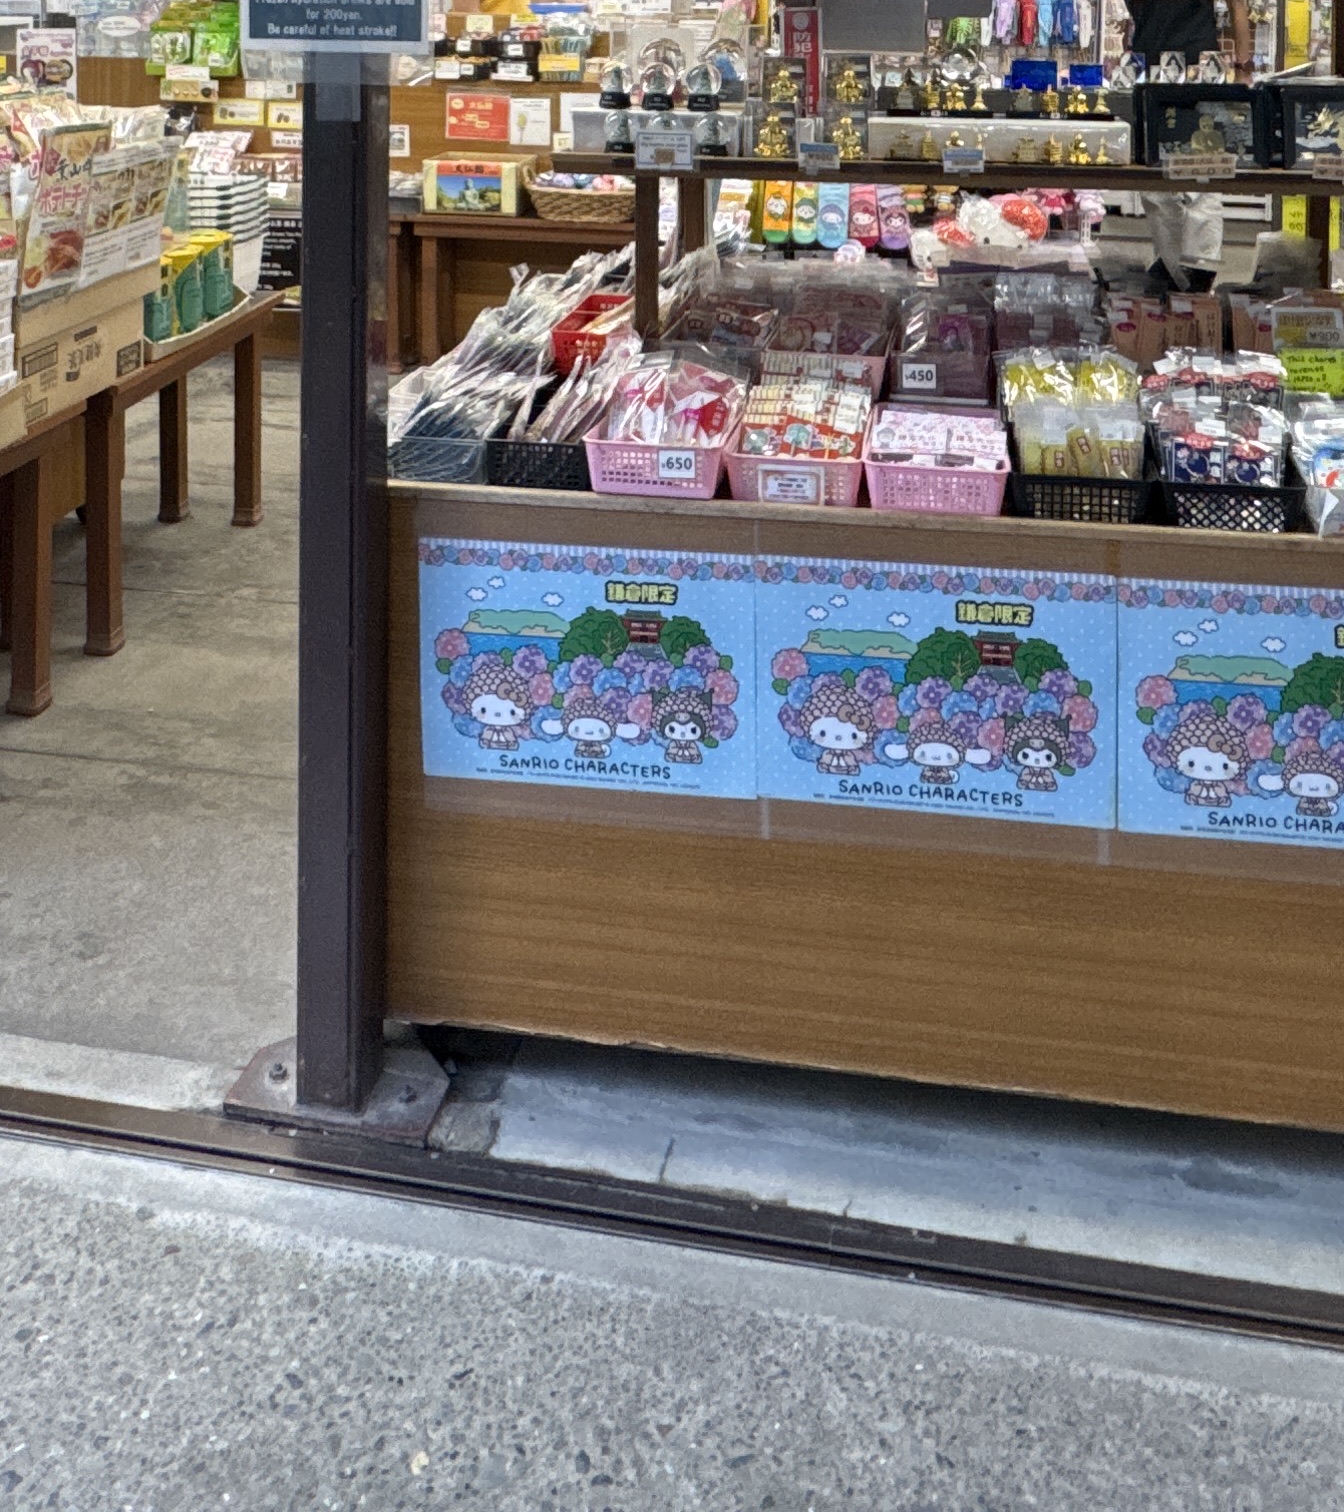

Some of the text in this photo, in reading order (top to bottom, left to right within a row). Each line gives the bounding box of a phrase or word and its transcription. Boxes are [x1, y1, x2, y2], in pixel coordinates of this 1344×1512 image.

[306, 9, 319, 20] for
[268, 23, 280, 35] Be
[283, 23, 317, 36] careful
[320, 24, 330, 35] of
[334, 24, 355, 36] heat
[906, 369, 934, 382] ¥450
[661, 454, 694, 473] ¥650
[605, 581, 678, 605] 鎌倉限定
[956, 601, 1034, 626] 鎌倉限定
[499, 753, 559, 772] SANRIO
[564, 758, 671, 781] CHARACTERS
[838, 778, 903, 797] SANRIO
[909, 784, 1023, 807] CHARACTERS
[1207, 811, 1276, 831] SANRIO
